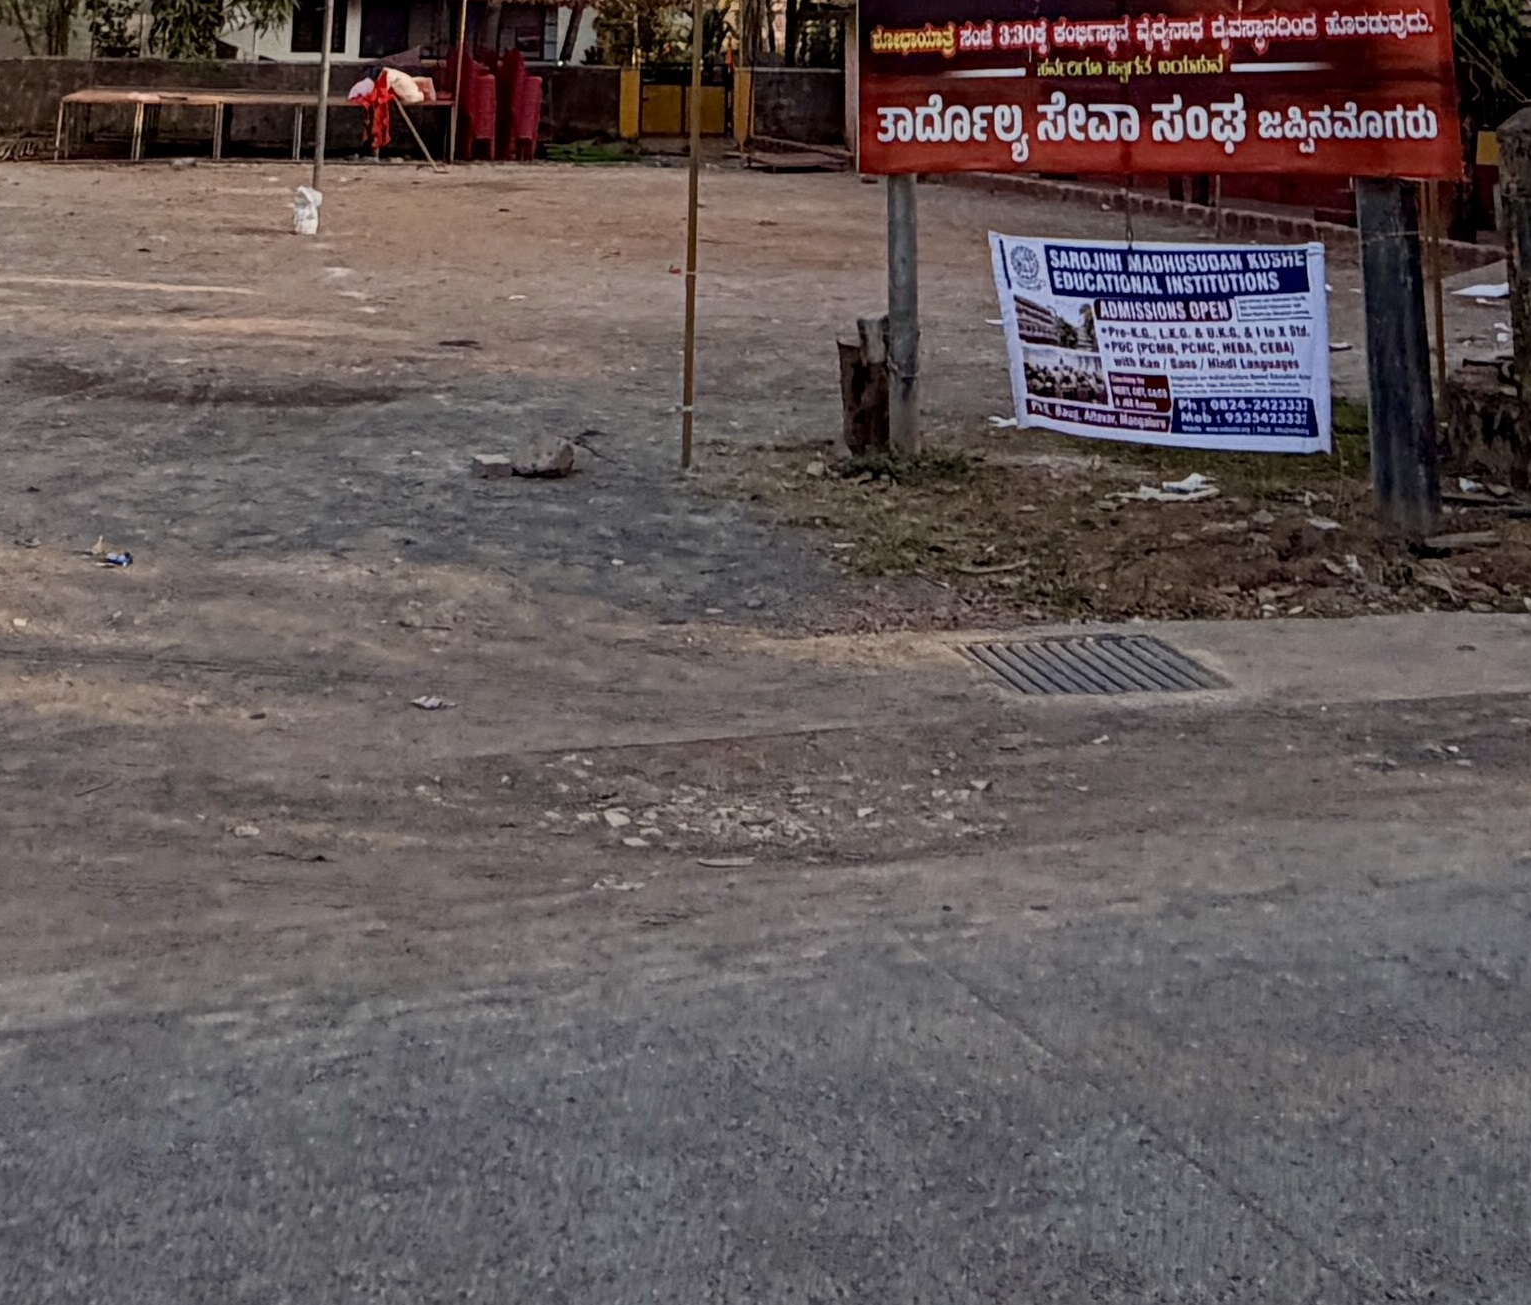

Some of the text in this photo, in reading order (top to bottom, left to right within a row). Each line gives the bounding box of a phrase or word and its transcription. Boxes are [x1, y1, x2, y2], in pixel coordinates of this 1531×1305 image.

[1037, 91, 1140, 142] ಸೇವಾ
[1151, 93, 1247, 154] ಸಂಘ
[1258, 101, 1438, 154] ಜಪ್ಪಿನಮೊಗರು
[1049, 249, 1306, 274] SAROJINI MADHUSUDAN KUSHE
[1053, 271, 1280, 295] EDUCATIONAL INSTITUTIONS
[1099, 300, 1229, 321] ADMISSIONS OPEN
[1240, 358, 1300, 372] Languages
[1178, 398, 1197, 410] Ph
[1180, 411, 1212, 423] Mob
